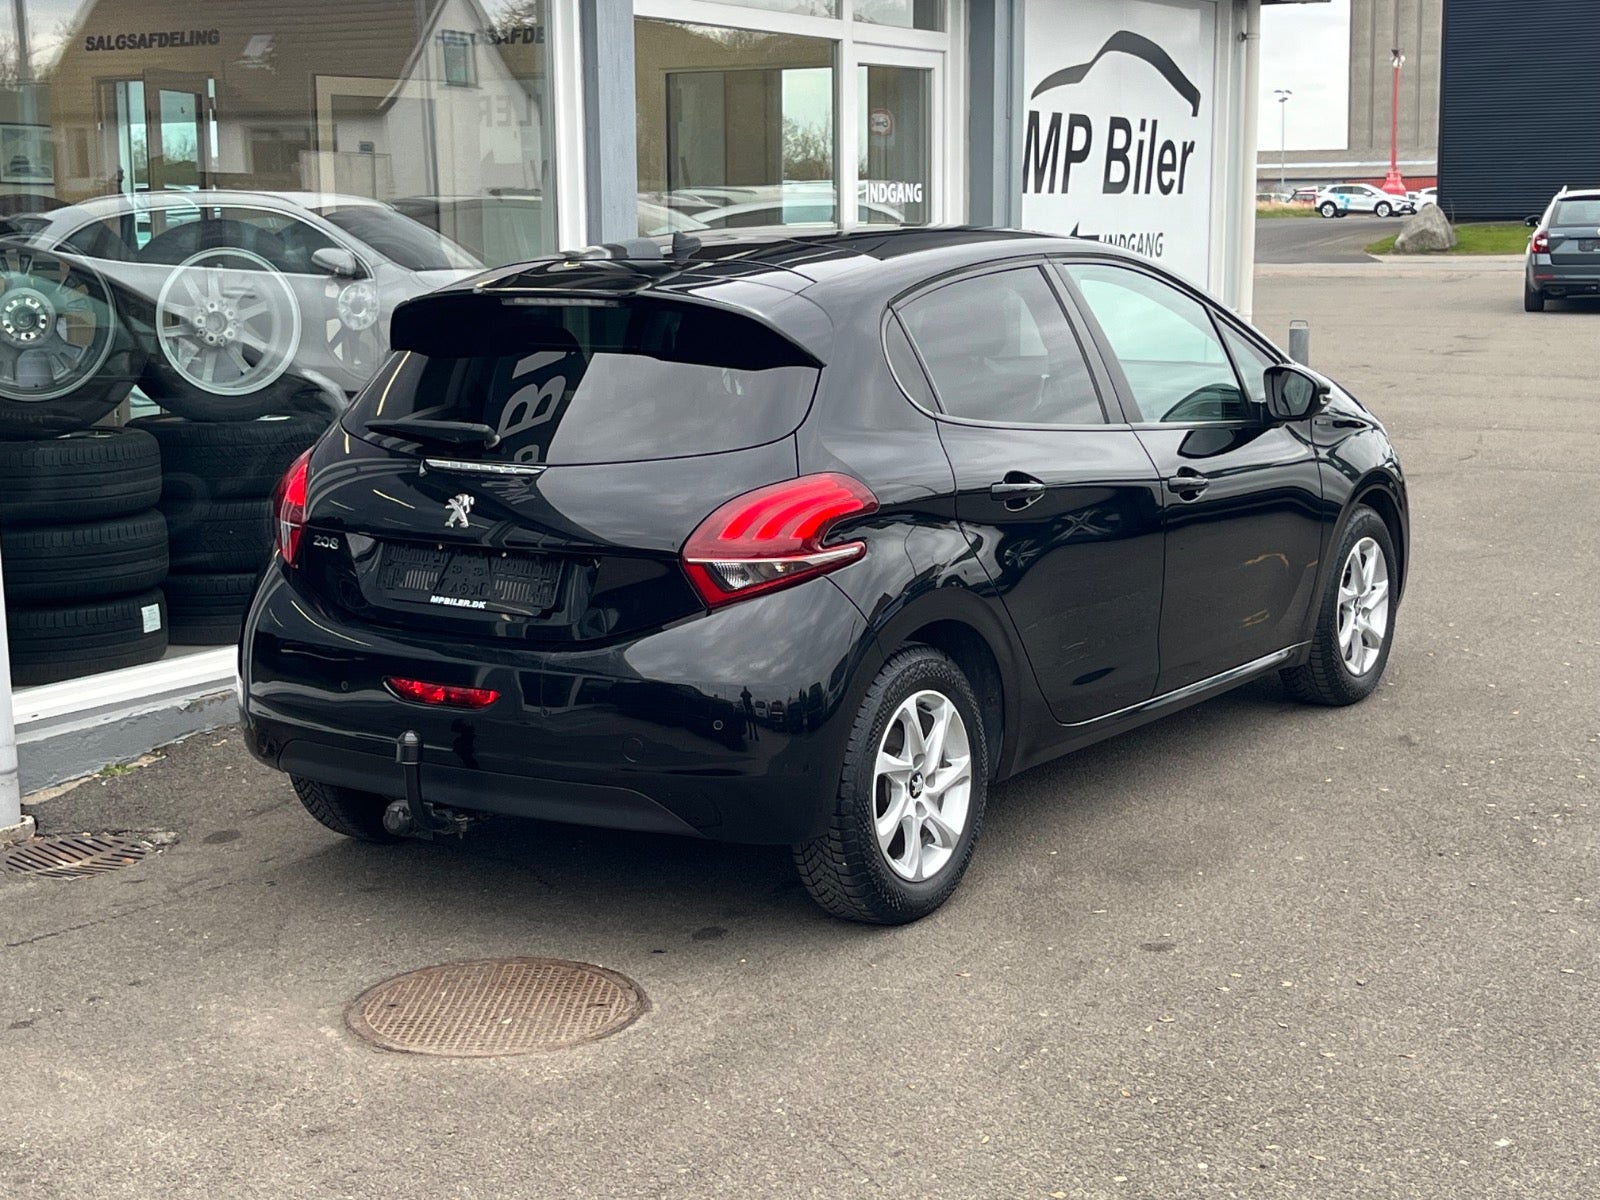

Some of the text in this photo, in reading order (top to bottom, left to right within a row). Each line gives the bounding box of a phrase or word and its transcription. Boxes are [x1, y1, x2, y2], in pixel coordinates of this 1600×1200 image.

[85, 28, 220, 51] SALGSAFDELING
[1023, 110, 1196, 195] MP Biler
[866, 182, 923, 203] INDGANG
[1103, 232, 1164, 258] DGANG
[313, 535, 339, 550] 208
[430, 595, 487, 609] MPBILER.DK
